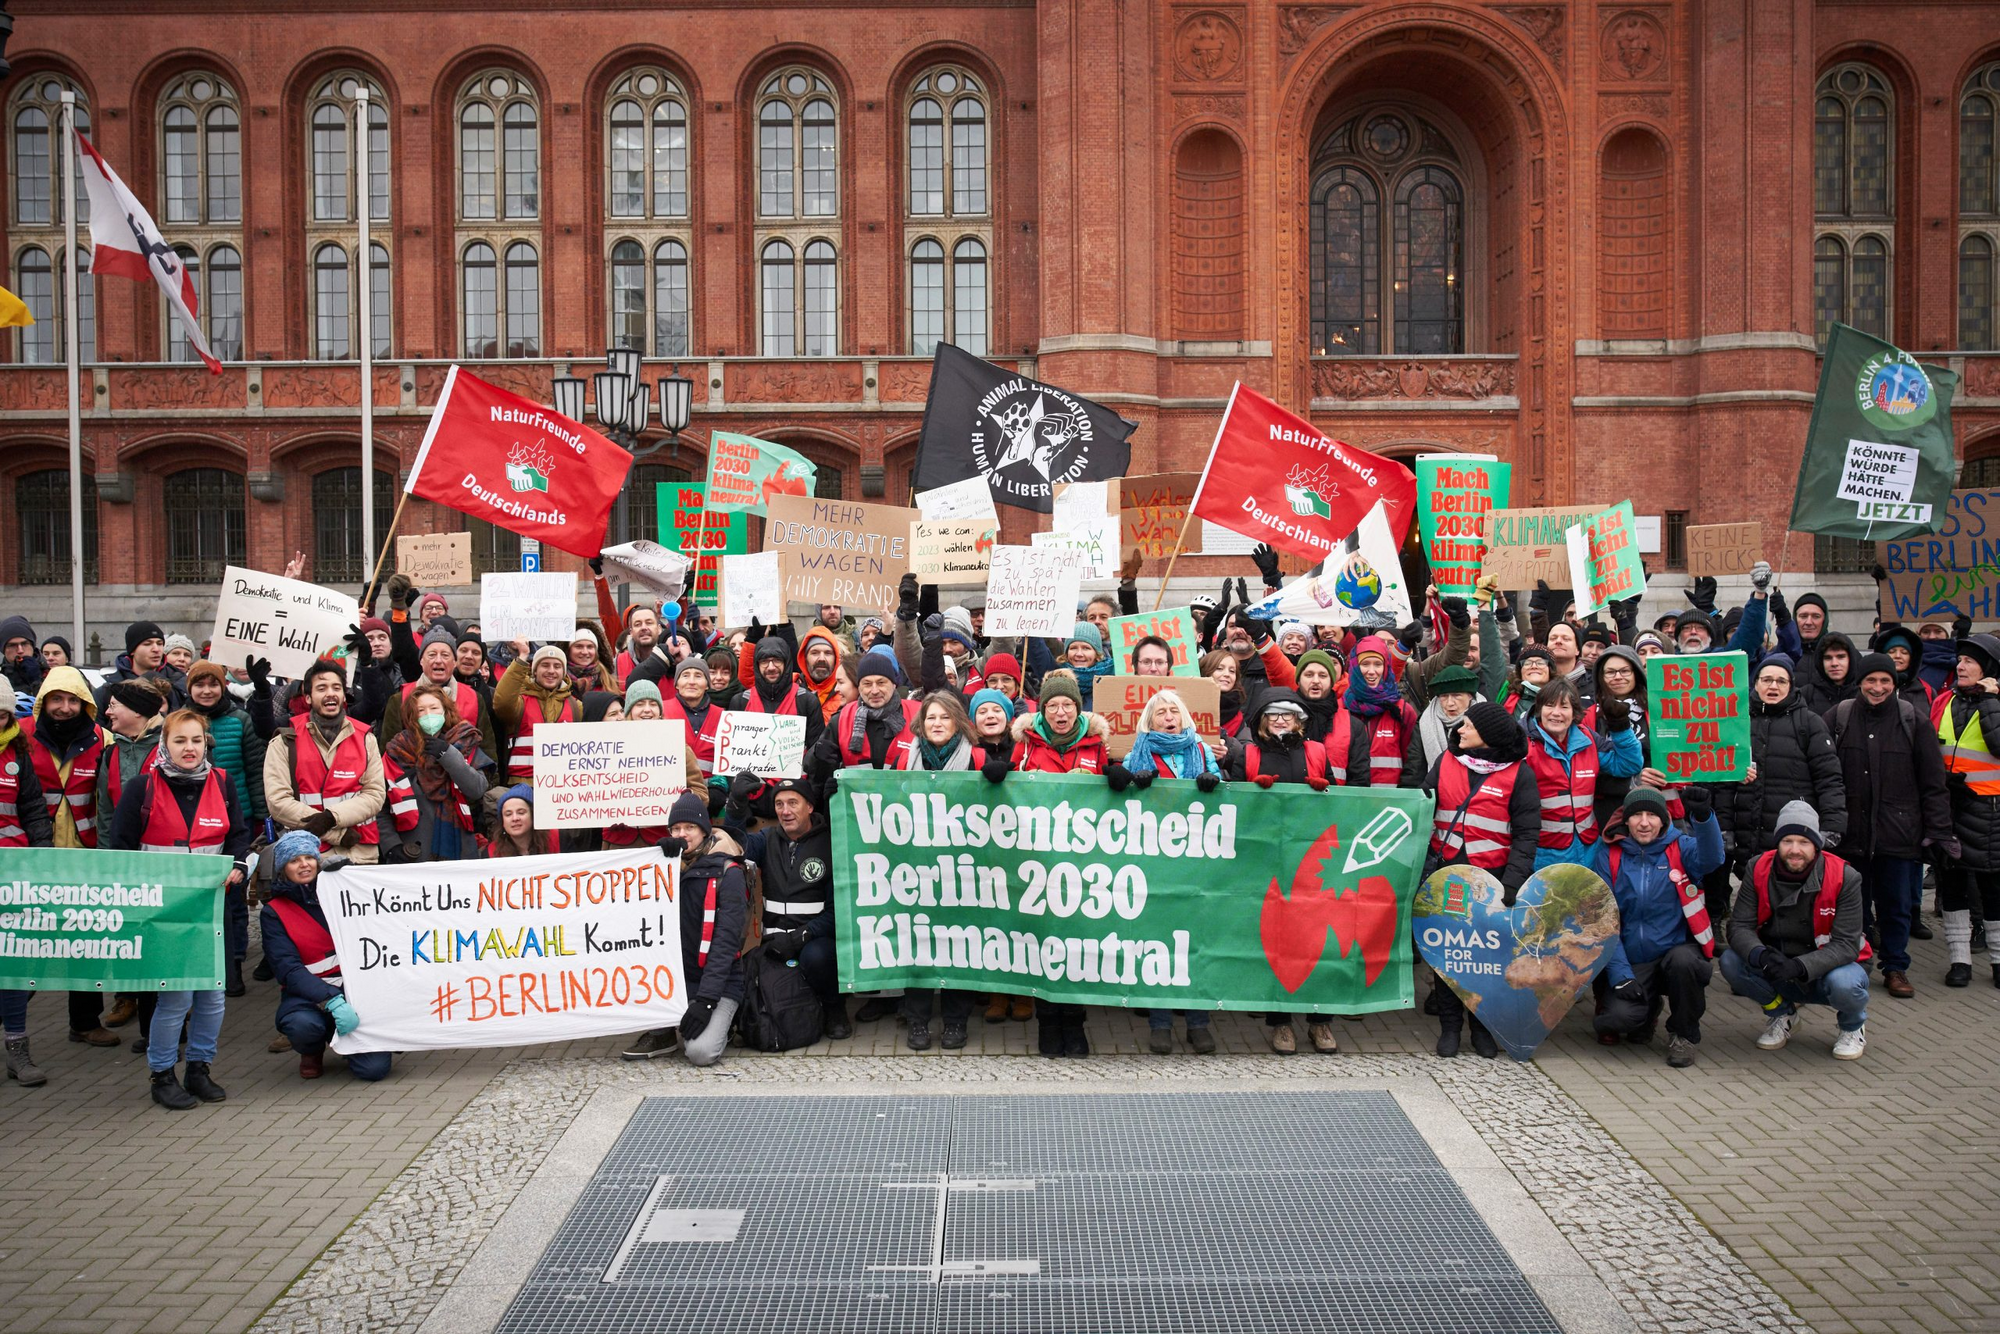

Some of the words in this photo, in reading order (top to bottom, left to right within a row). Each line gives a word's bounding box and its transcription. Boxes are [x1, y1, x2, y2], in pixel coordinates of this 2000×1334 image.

[1859, 359, 1880, 410] BERLIN
[1883, 353, 1892, 364] 4
[976, 378, 1027, 418] ANIMAL
[490, 406, 586, 455] NaturFreunde
[716, 439, 760, 460] Berlin
[1269, 424, 1378, 488] NaturFreunde
[1853, 445, 1907, 463] KÖNNTE
[714, 456, 751, 475] 2030
[971, 432, 1003, 488] HUMAN
[1007, 455, 1089, 497] LIBERTION
[1850, 457, 1897, 475] WÜRDE
[711, 472, 757, 492] klima-
[1435, 467, 1489, 490] Mach
[1847, 470, 1885, 486] HÄTTE
[461, 473, 567, 525] Deutschlands
[678, 488, 704, 508] Ma
[709, 490, 760, 506] neutral
[1430, 491, 1493, 513] Berlin
[1844, 483, 1904, 502] MACHEN.
[674, 509, 731, 528] Berlin
[813, 502, 864, 526] MEHR
[1599, 510, 1624, 536] ist
[1860, 502, 1927, 522] JETZT.
[916, 524, 932, 538] Yes
[938, 527, 950, 535] we
[1241, 495, 1344, 552] Deutschland
[1435, 515, 1484, 537] 2030
[421, 539, 442, 552] mehr
[680, 530, 727, 549] 2030
[772, 519, 904, 559] DEMOKRATIE
[944, 542, 973, 554] wählen
[1588, 529, 1629, 562] icht
[1691, 526, 1752, 548] KEINE
[402, 552, 464, 573] Demokratie
[526, 557, 536, 572] P
[801, 552, 883, 575] WAGEN
[991, 546, 1012, 567] Es
[1021, 549, 1046, 565] ist
[1052, 550, 1082, 568] nicht
[1594, 554, 1619, 578] zu
[1691, 548, 1757, 572] TRICKS
[1887, 538, 2000, 573] BERLIN
[421, 572, 449, 585] wagen
[1029, 566, 1063, 584] spät
[234, 579, 283, 601] Demokratie
[293, 595, 311, 605] und
[317, 597, 344, 613] Klima
[488, 576, 510, 598] 2
[990, 579, 1005, 595] die
[1016, 612, 1060, 635] legen!
[1121, 622, 1147, 647] Es
[1150, 616, 1183, 641] ist
[225, 618, 269, 644] EINE
[278, 626, 319, 653] Wahl
[1662, 664, 1695, 691] Es
[1698, 661, 1735, 689] ist
[1660, 691, 1738, 719] nicht
[1686, 721, 1721, 744] zu
[541, 741, 625, 757] DEMOKRATIE
[568, 757, 610, 770] ERNST
[618, 755, 677, 769] NEHMEN:
[718, 756, 777, 773] Demokratie
[1666, 744, 1736, 777] spät!
[536, 772, 649, 788] VOLKSENTSCHEID
[552, 792, 573, 804] UND
[556, 805, 669, 821] ZUSAMMENLEGEN
[850, 792, 1238, 860] Volksentscheid
[0, 881, 164, 907] olksentscheid
[340, 889, 371, 917] Ihr
[373, 885, 432, 915] Könnt
[437, 884, 471, 912] Uns
[477, 873, 550, 913] NICHT
[550, 862, 675, 909] STOPPEN
[854, 852, 1011, 911] Berlin
[1017, 860, 1148, 920] 2030
[0, 907, 57, 931] erlin
[62, 908, 124, 933] 2030
[0, 932, 143, 960] limaneutral
[359, 936, 401, 971] Die
[412, 924, 577, 966] KLIMAWAHL
[584, 914, 666, 954] Kommt!
[856, 913, 1191, 987] Klimaneutral
[1423, 928, 1501, 950] OMAS
[1444, 949, 1472, 961] FOR
[1445, 961, 1502, 975] FUTURE
[430, 964, 675, 1023] #BERLIN2030
